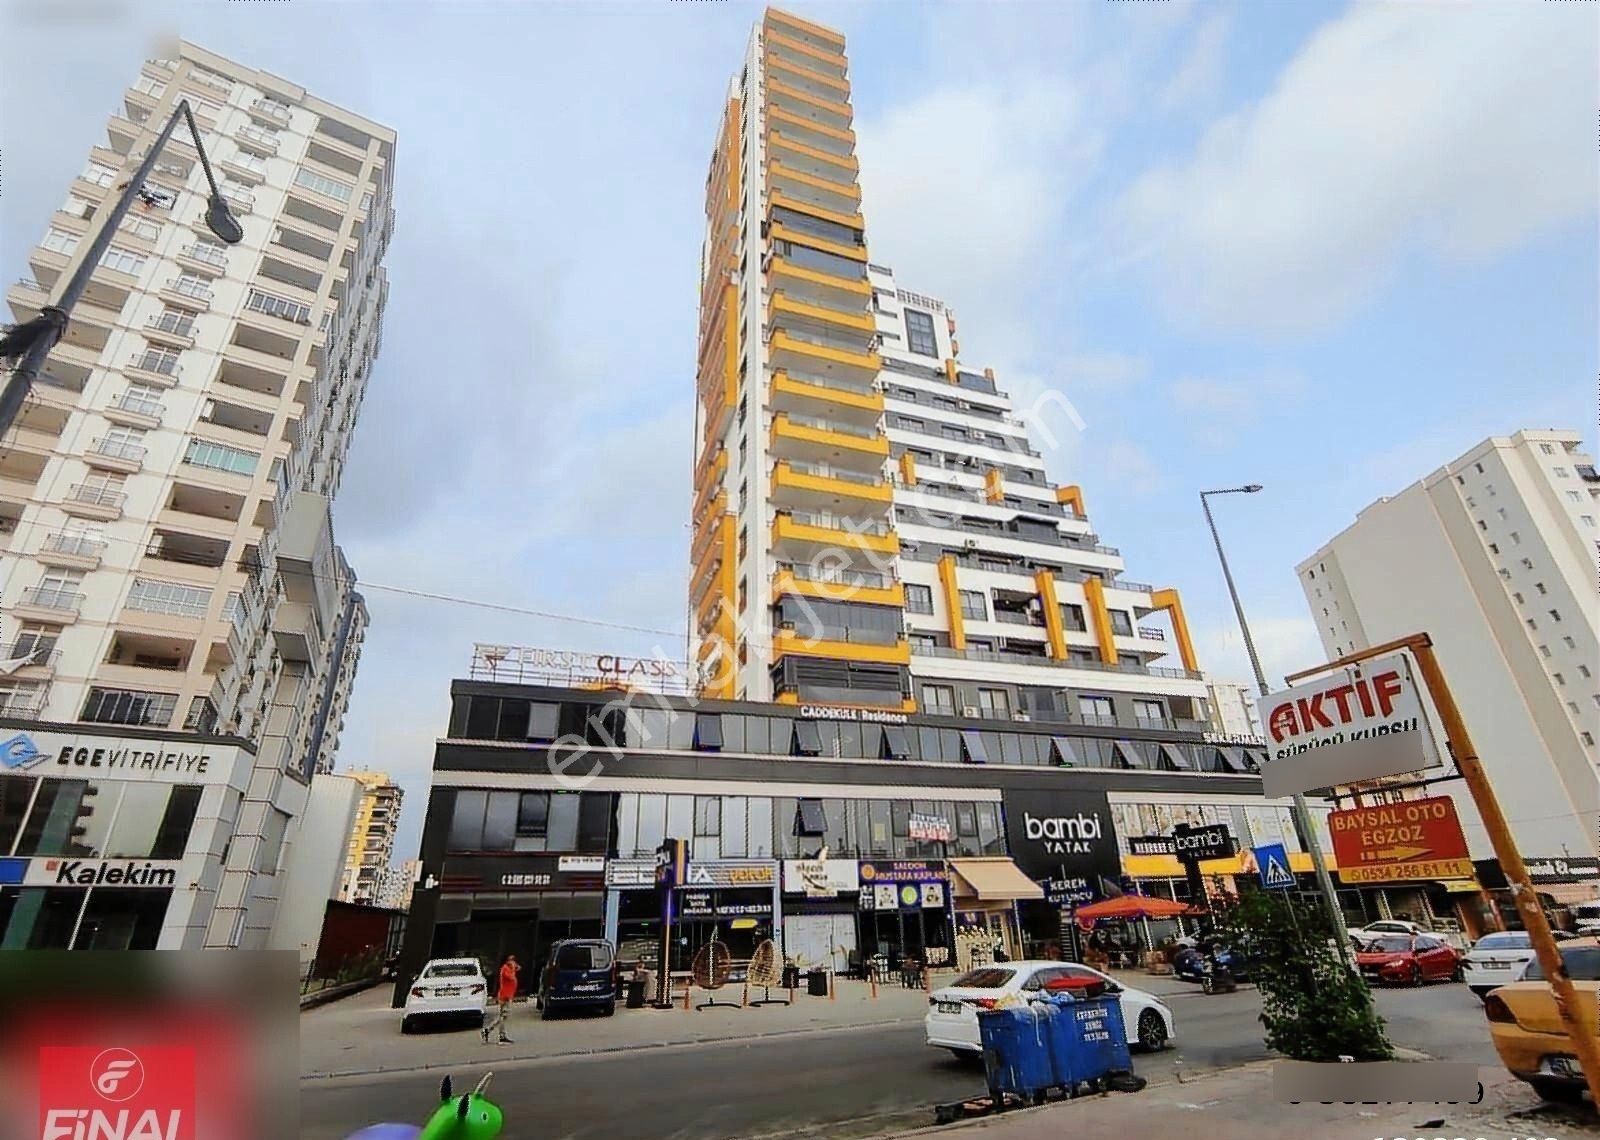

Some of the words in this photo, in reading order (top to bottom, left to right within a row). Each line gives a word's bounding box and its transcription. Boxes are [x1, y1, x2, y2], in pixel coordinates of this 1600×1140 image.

[1024, 812, 1101, 840] bambi
[1334, 811, 1402, 831] BAYSAL
[1406, 803, 1446, 820] OTO
[1175, 829, 1224, 850] bambi
[1362, 825, 1424, 846] EGZOZ
[1044, 841, 1091, 854] YATAK
[56, 861, 176, 885] Kalekim
